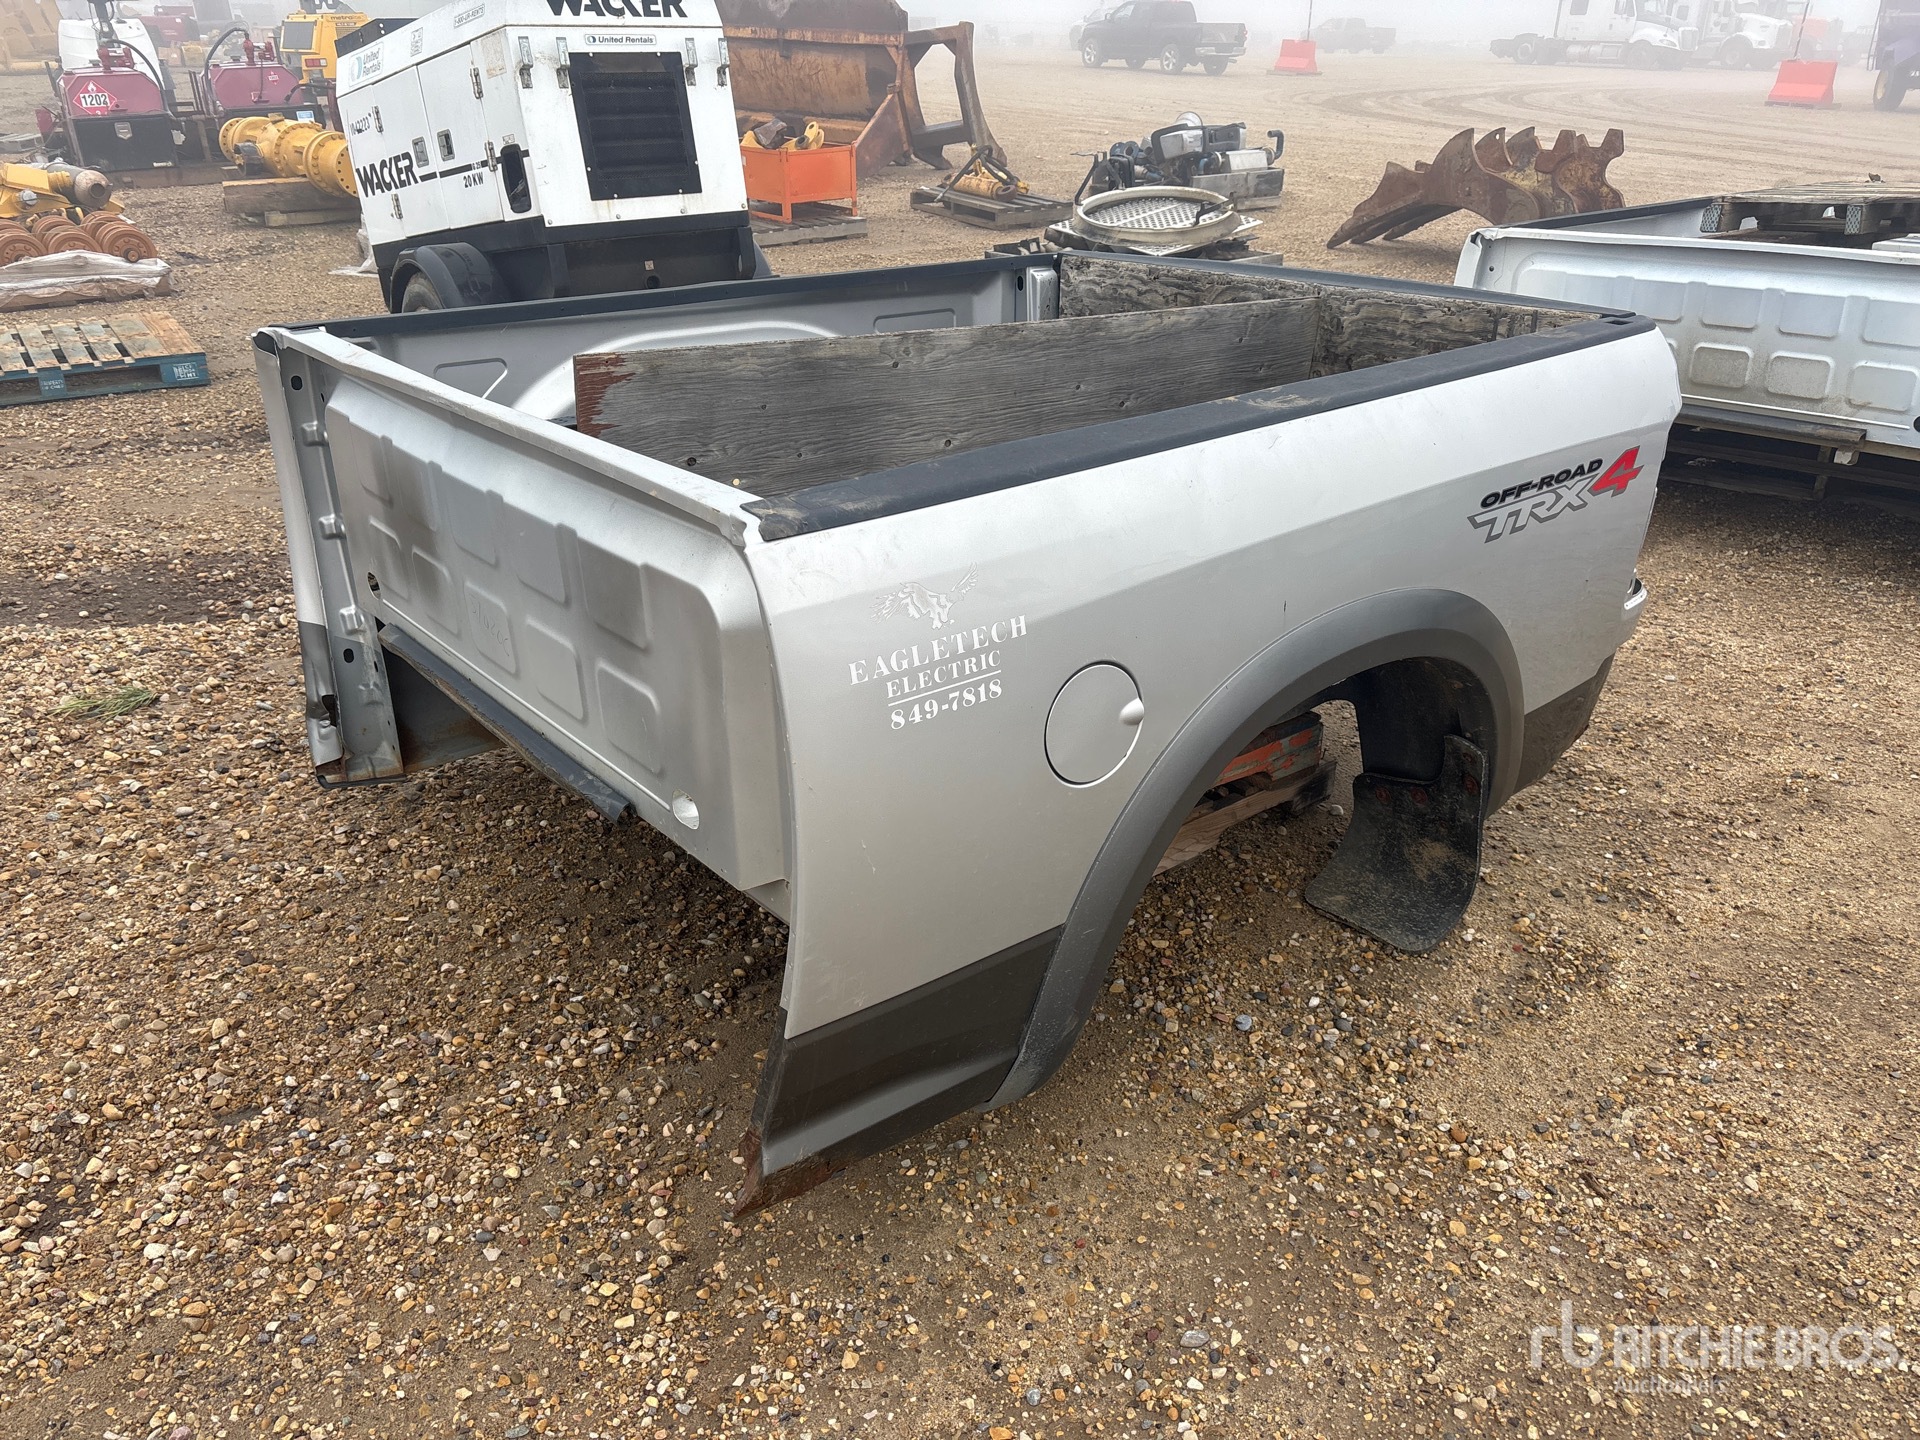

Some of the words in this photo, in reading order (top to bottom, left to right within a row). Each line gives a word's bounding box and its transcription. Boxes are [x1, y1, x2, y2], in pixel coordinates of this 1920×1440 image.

[598, 36, 624, 44] United
[626, 36, 654, 44] Rentals
[81, 94, 109, 106] 1202
[356, 151, 419, 198] WACKER
[1480, 458, 1603, 509] OFF-ROAD
[849, 615, 1027, 686] EAGLETECH
[886, 650, 1001, 699] ELECTRIC
[891, 678, 1002, 730] 849-7818
